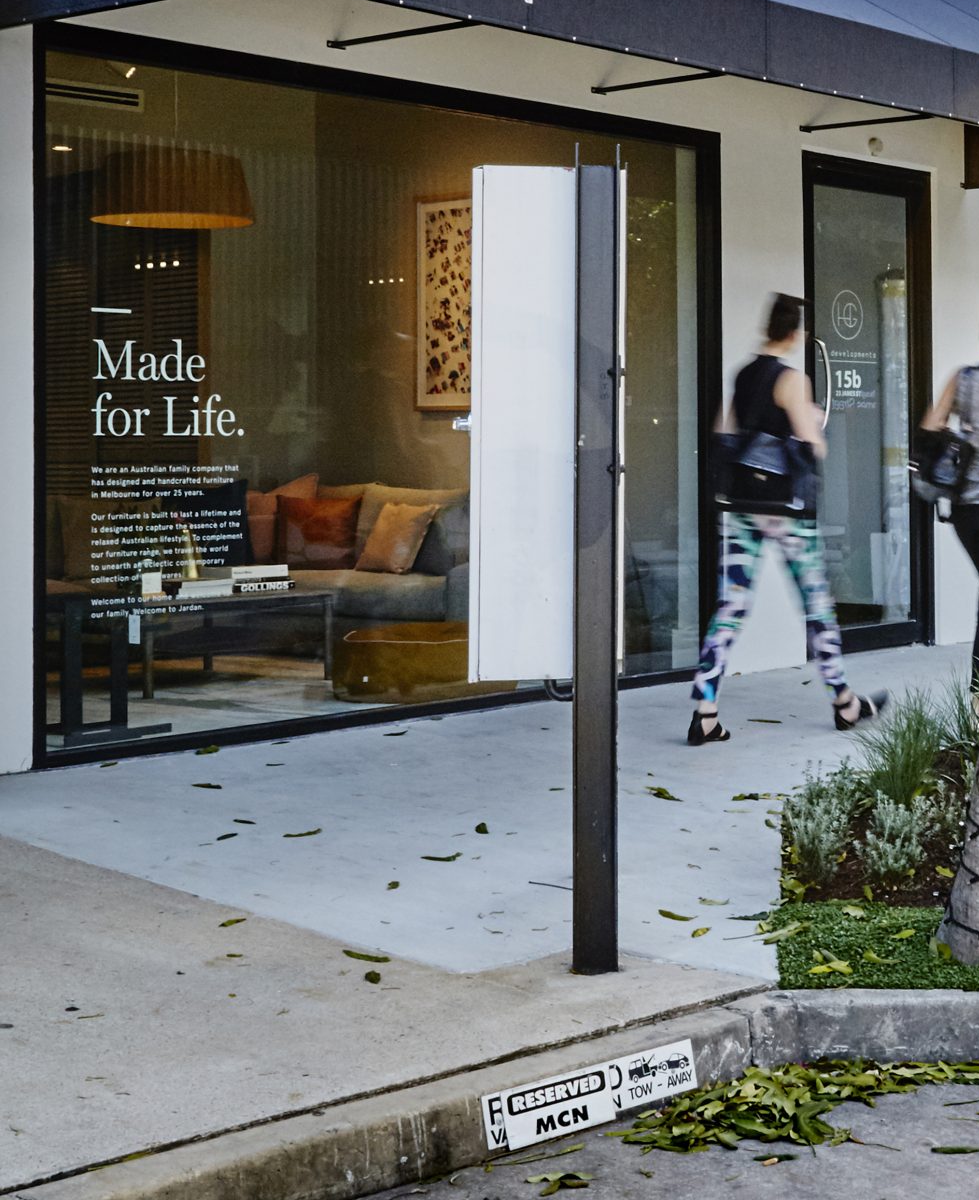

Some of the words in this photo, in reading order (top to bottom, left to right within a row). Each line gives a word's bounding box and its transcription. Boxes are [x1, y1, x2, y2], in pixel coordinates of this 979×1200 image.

[92, 338, 206, 383] Made
[835, 369, 862, 389] 15b
[91, 392, 150, 437] for
[162, 393, 245, 438] Life.
[91, 465, 103, 474] We
[130, 465, 167, 474] Australian
[169, 465, 190, 474] family
[192, 465, 223, 473] company
[224, 464, 239, 472] that
[106, 478, 140, 488] designed
[142, 478, 155, 486] and
[157, 477, 201, 485] handcrafted
[203, 476, 234, 484] furniture
[91, 490, 99, 498] in
[101, 490, 140, 498] Melbourne
[173, 489, 182, 497] 25
[184, 490, 205, 498] years.
[91, 512, 105, 521] Our
[107, 512, 141, 521] furniture
[151, 511, 168, 519] built
[180, 510, 193, 518] last
[201, 509, 227, 517] lifetime
[100, 525, 133, 535] designed
[145, 524, 174, 532] capture
[189, 522, 218, 530] essence
[219, 521, 227, 529] of
[91, 538, 119, 546] relaxed
[121, 536, 158, 545] Australian
[192, 533, 201, 541] To
[202, 532, 243, 541] complement
[91, 551, 104, 559] our
[105, 550, 138, 558] furniture
[209, 544, 229, 552] world
[101, 562, 131, 571] unearth
[144, 559, 174, 568] eclectic
[175, 558, 225, 567] conmporary
[91, 574, 130, 584] collection
[131, 573, 139, 581] of
[91, 596, 126, 606] Welcome
[127, 595, 136, 603] to
[137, 595, 150, 603] our
[152, 593, 173, 601] home
[91, 611, 104, 619] our
[132, 606, 167, 615] Welcome
[168, 605, 177, 613] to
[179, 603, 204, 612] Jardan.
[628, 1083, 653, 1101] TOW
[667, 1069, 694, 1090] AWAY
[511, 1072, 602, 1113] RESERVED
[536, 1104, 590, 1136] MCN
